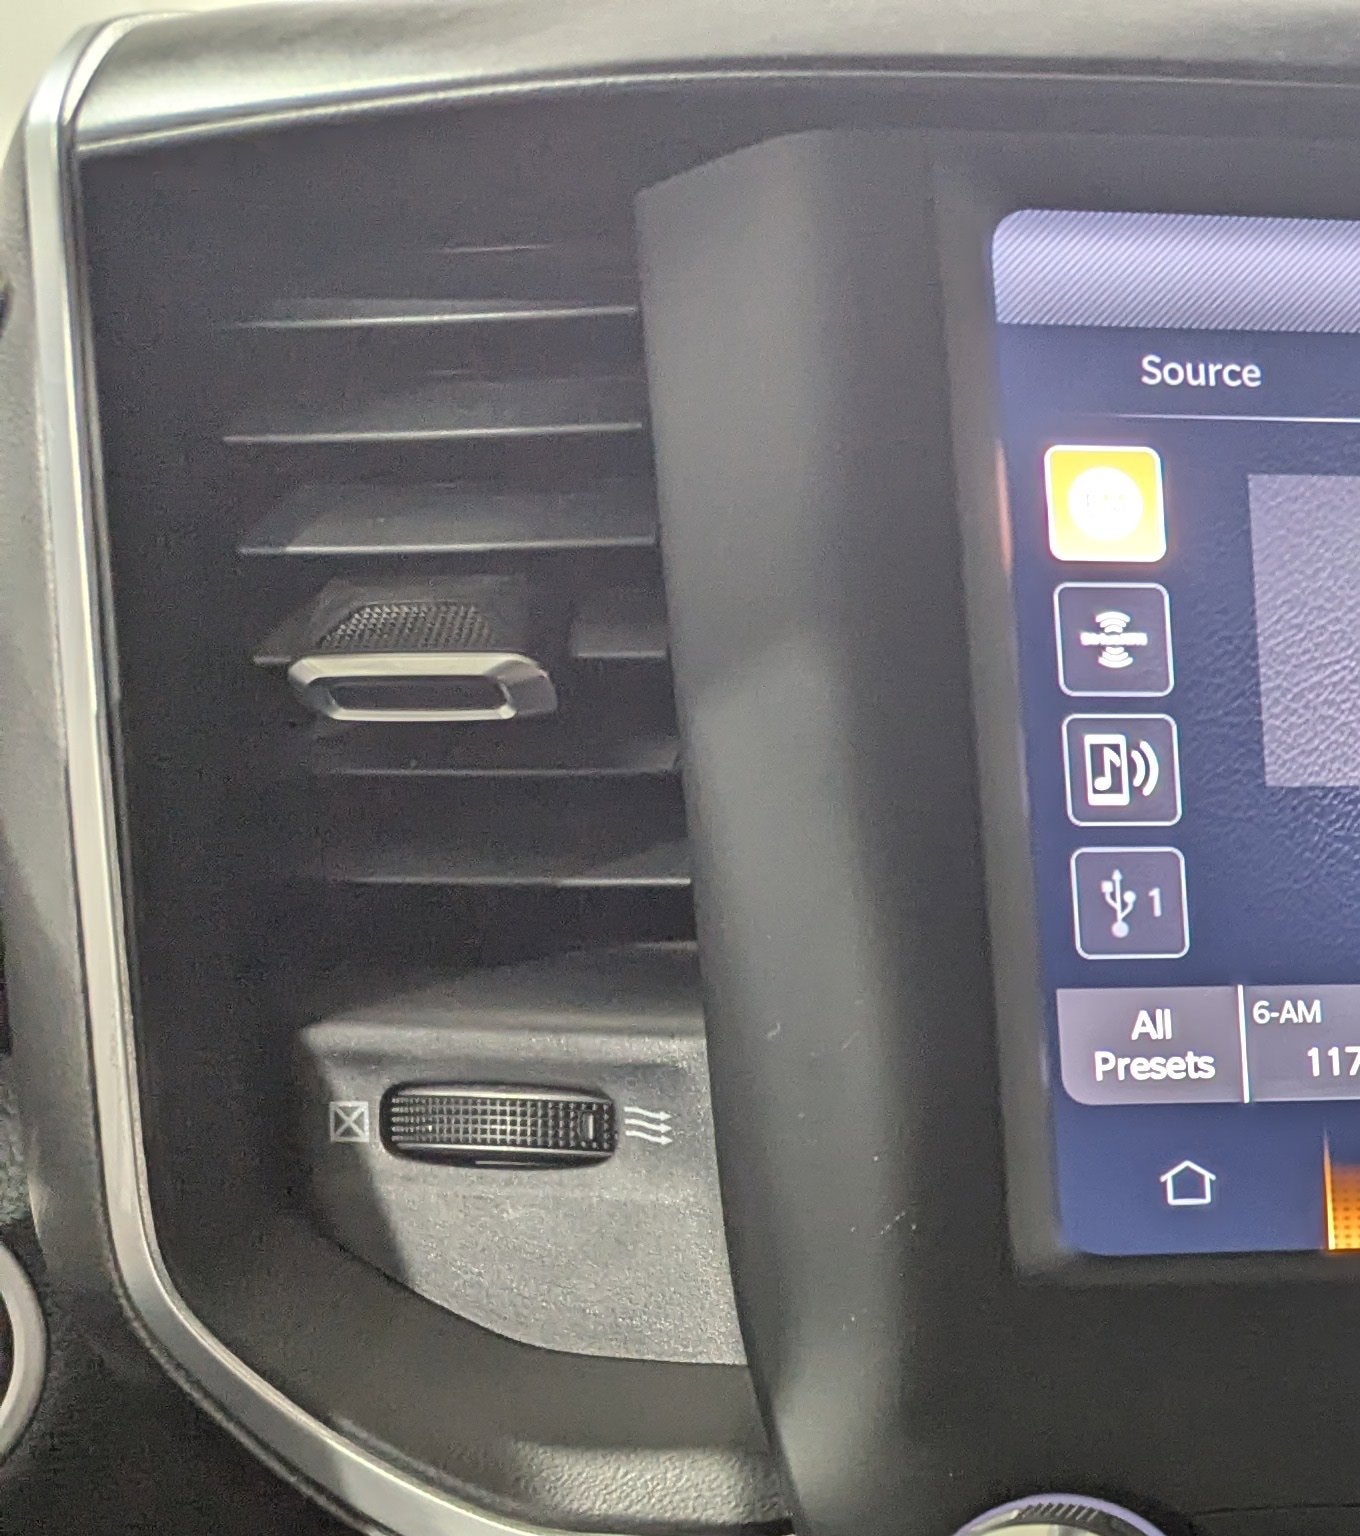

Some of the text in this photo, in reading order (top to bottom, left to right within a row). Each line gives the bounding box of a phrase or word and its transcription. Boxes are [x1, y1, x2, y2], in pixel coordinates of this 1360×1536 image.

[1141, 356, 1262, 388] Source
[1149, 888, 1163, 917] 1
[1131, 1008, 1173, 1039] All
[1252, 1000, 1321, 1024] 6-AM
[1095, 1050, 1215, 1082] Presets
